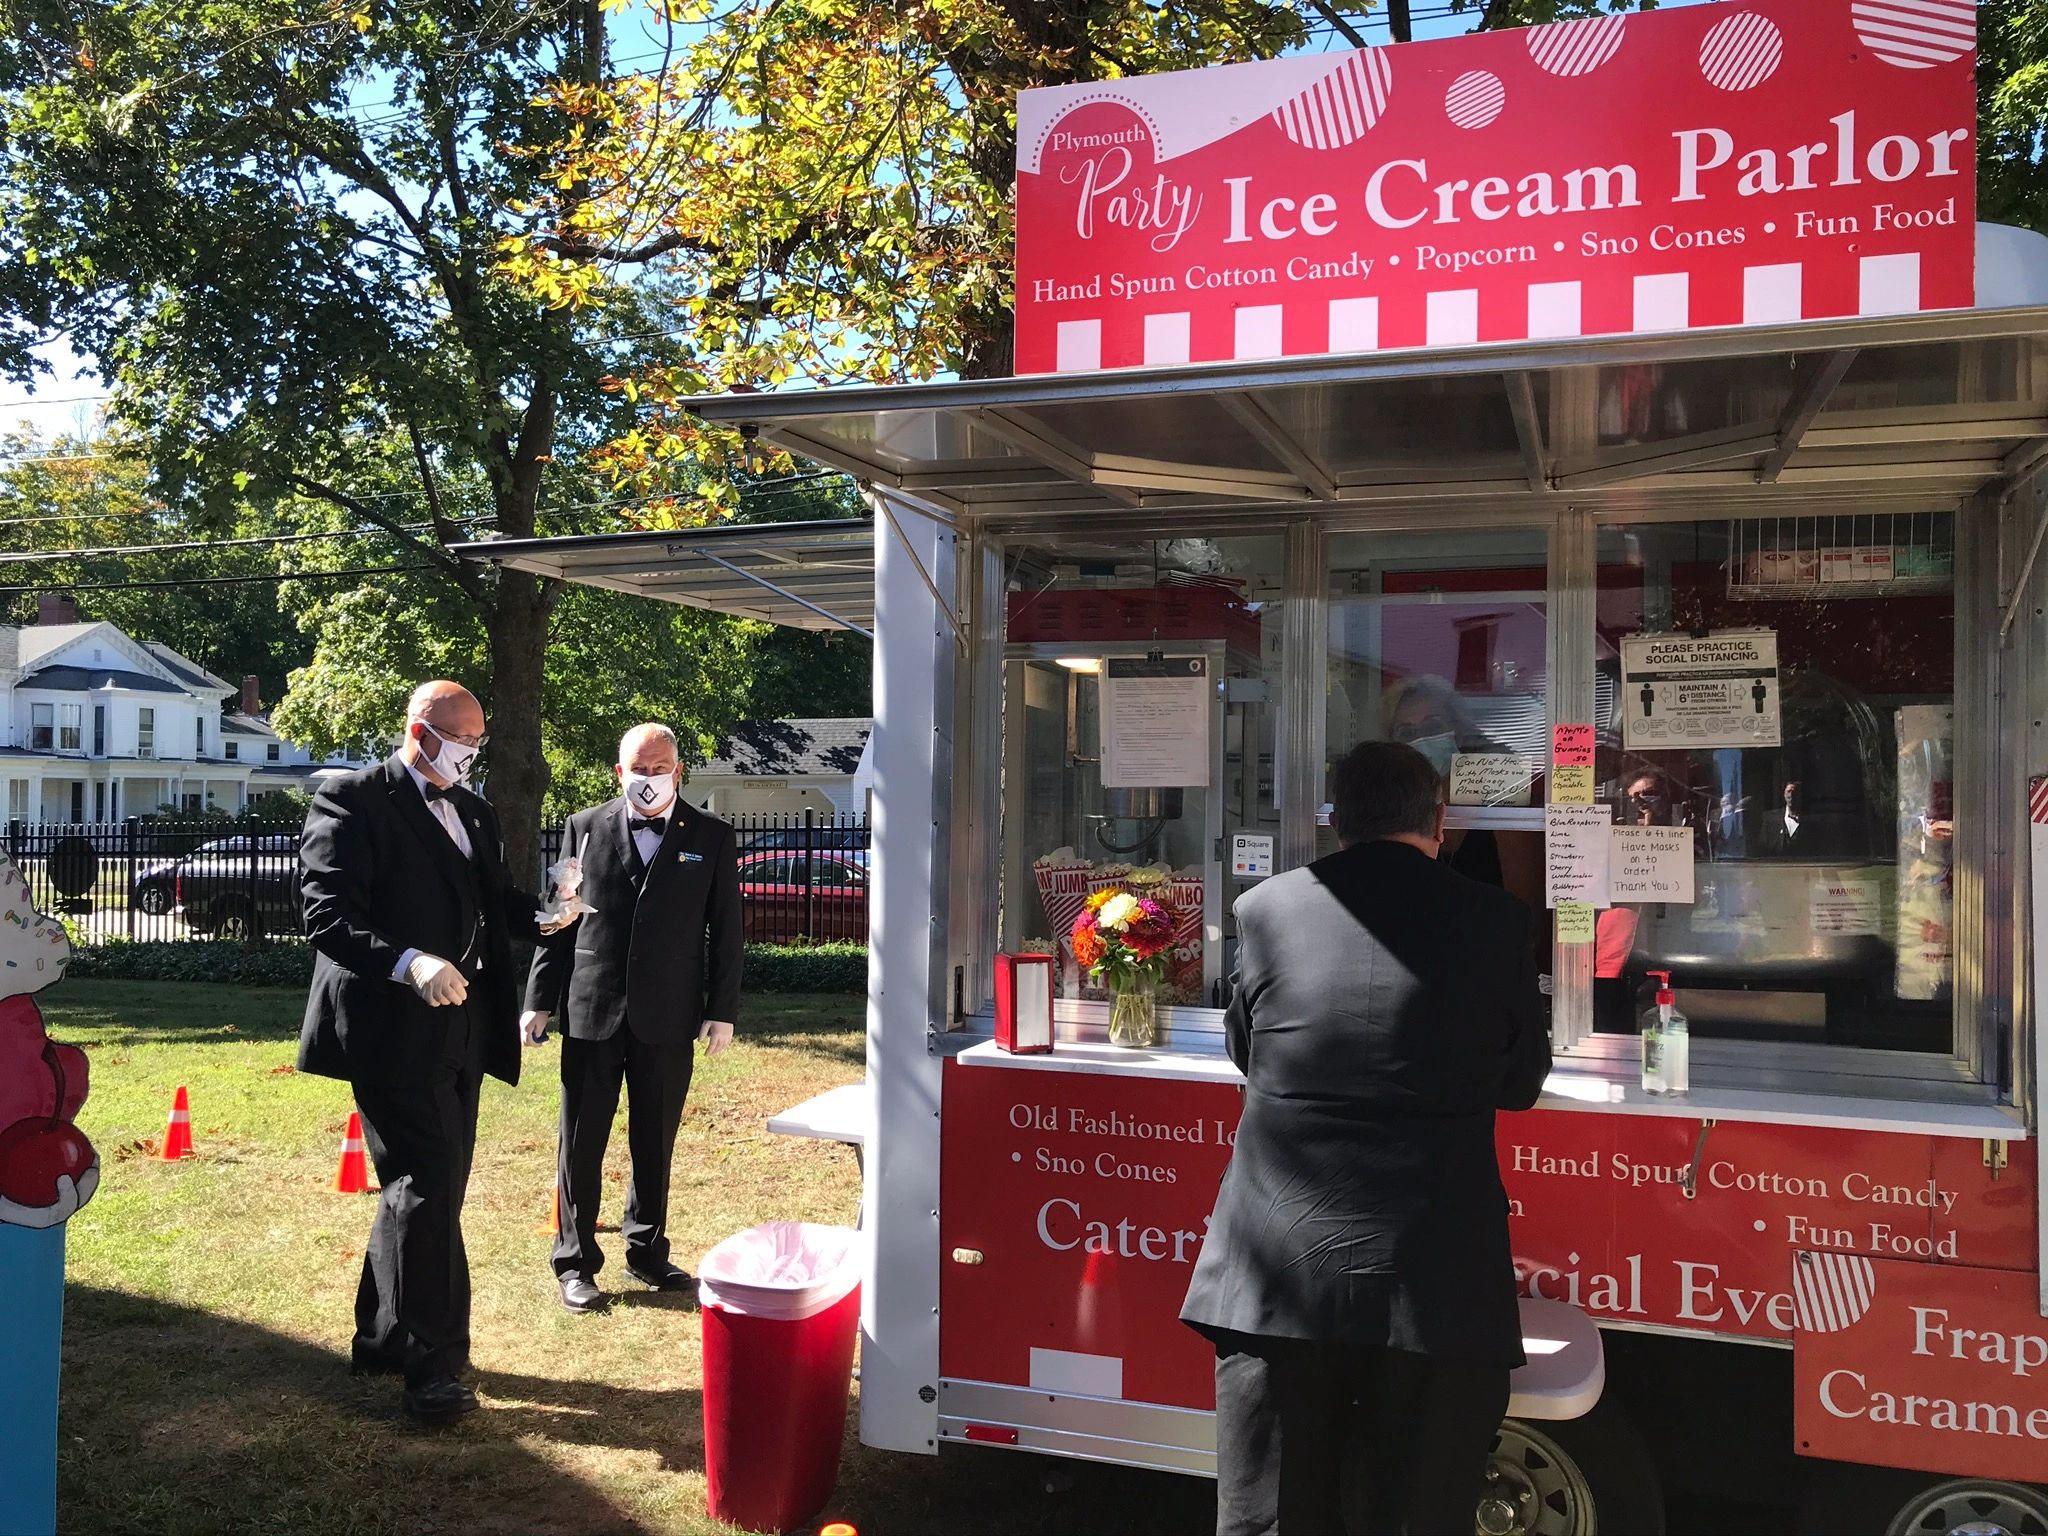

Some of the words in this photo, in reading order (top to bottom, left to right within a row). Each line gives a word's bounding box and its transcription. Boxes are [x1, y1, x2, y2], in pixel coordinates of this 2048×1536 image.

[1052, 123, 1146, 152] Plymouth
[1222, 175, 1338, 244] Ice
[1365, 158, 1642, 229] Cream
[1671, 109, 1968, 203] Parlor
[1059, 146, 1203, 252] Party
[1032, 273, 1102, 303] Hand
[1110, 272, 1176, 299] Spun
[1185, 265, 1278, 289] Cotton
[1286, 251, 1375, 281] Candy
[1415, 241, 1537, 272] Popcorn
[1581, 231, 1639, 257] Sno
[1650, 222, 1746, 251] Cones
[1794, 210, 1861, 239] Fun
[1872, 198, 1957, 231] Food
[1651, 643, 1694, 654] PLEASE
[1697, 641, 1753, 652] PRACTICE
[1645, 653, 1688, 664] SOCIAL
[1690, 651, 1759, 663] DISTANCING
[1679, 684, 1719, 692] MAINTAIN
[1721, 683, 1727, 691] A
[1690, 691, 1727, 699] DISTANCE
[1554, 743, 1591, 753] Gummies
[1612, 828, 1640, 837] Please
[1655, 829, 1664, 838] ft
[1246, 840, 1270, 848] Square
[1621, 842, 1646, 852] Have
[1650, 842, 1680, 852] Masks
[1645, 855, 1658, 864] to
[1054, 870, 1088, 894] JUMB
[1614, 881, 1647, 892] Thank
[1009, 1103, 1058, 1131] Old
[1068, 1107, 1205, 1143] Fashioned
[1511, 1144, 1600, 1178] Hand
[1708, 1161, 1829, 1199] Cotton
[1842, 1172, 1959, 1215] Candy
[1035, 1147, 1085, 1175] Sno
[1094, 1152, 1177, 1184] Cones
[1787, 1214, 1856, 1249] Fun
[1869, 1222, 1959, 1259] Food
[1908, 1306, 2048, 1377] Frap
[1819, 1368, 2048, 1440] Carame
